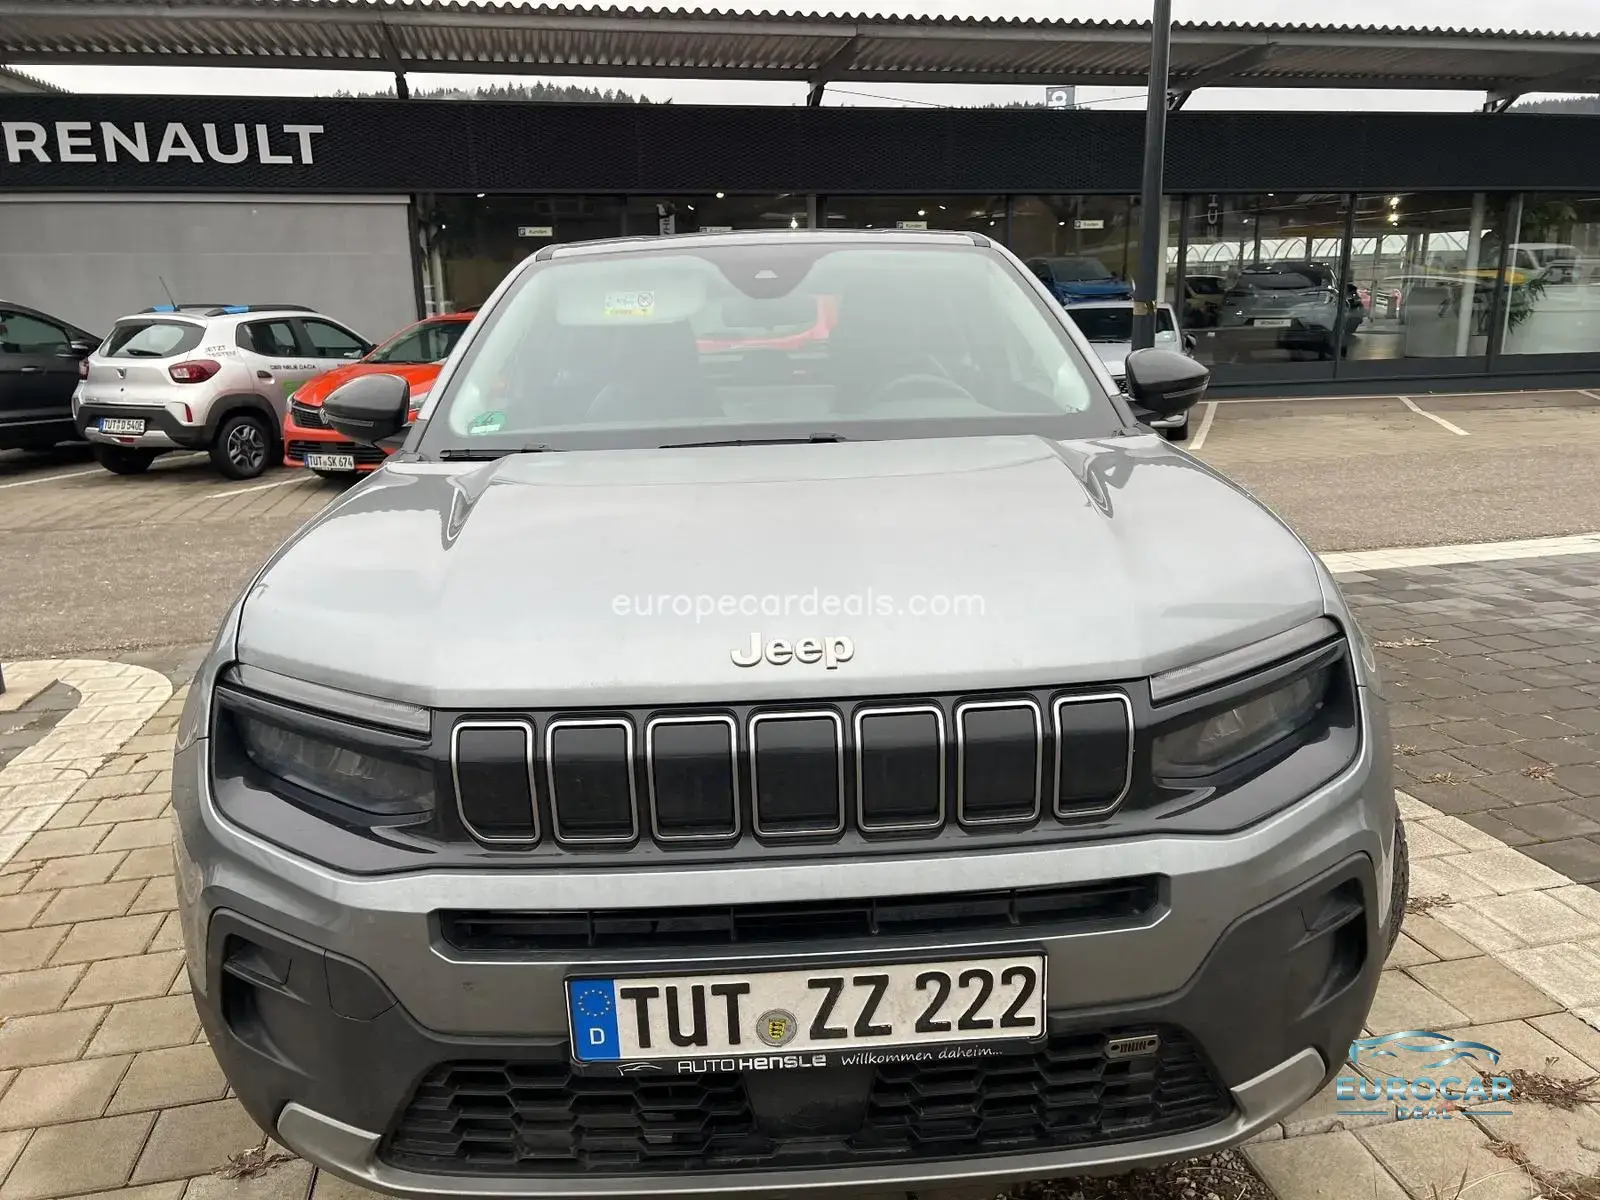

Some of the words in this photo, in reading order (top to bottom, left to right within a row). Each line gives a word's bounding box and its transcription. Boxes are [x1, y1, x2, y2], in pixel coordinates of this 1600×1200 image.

[1, 121, 324, 164] RENAULT
[730, 631, 856, 670] Jeep
[620, 982, 751, 1048] TUT
[807, 974, 893, 1040] ZZ
[915, 966, 1037, 1033] 222
[590, 1027, 606, 1045] D
[677, 1057, 735, 1074] AUTO
[841, 1051, 933, 1067] Willkommen
